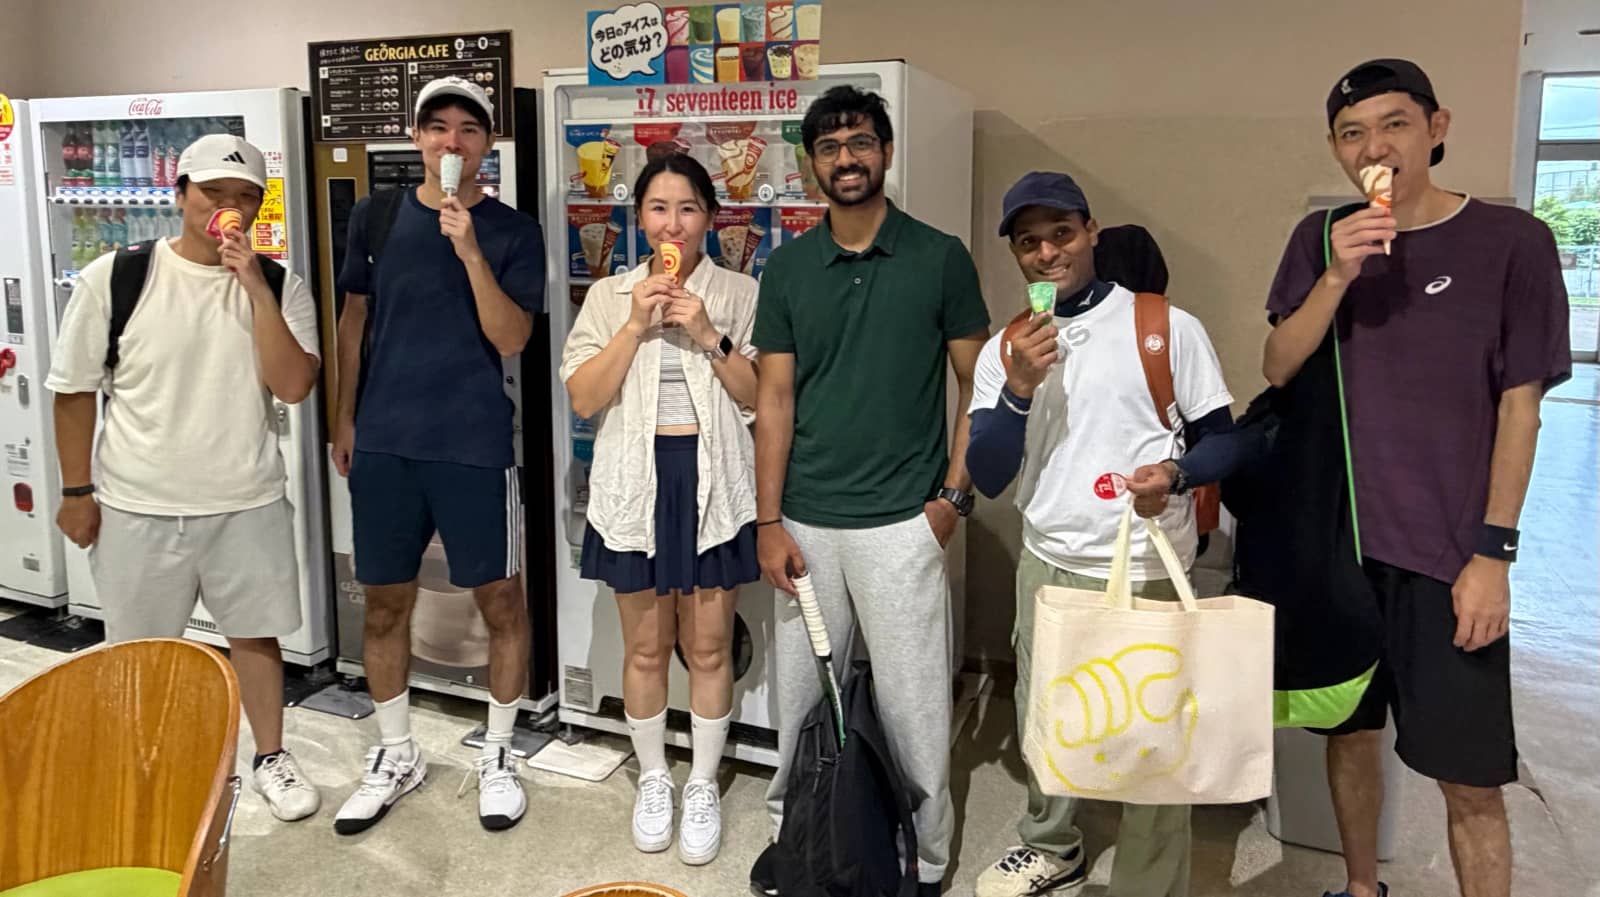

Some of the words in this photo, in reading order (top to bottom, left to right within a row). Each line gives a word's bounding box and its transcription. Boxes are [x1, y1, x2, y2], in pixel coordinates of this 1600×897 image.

[595, 16, 658, 42] 今日のアイスは
[418, 44, 449, 58] CAFE
[666, 87, 763, 113] seventeen
[768, 82, 797, 110] ice
